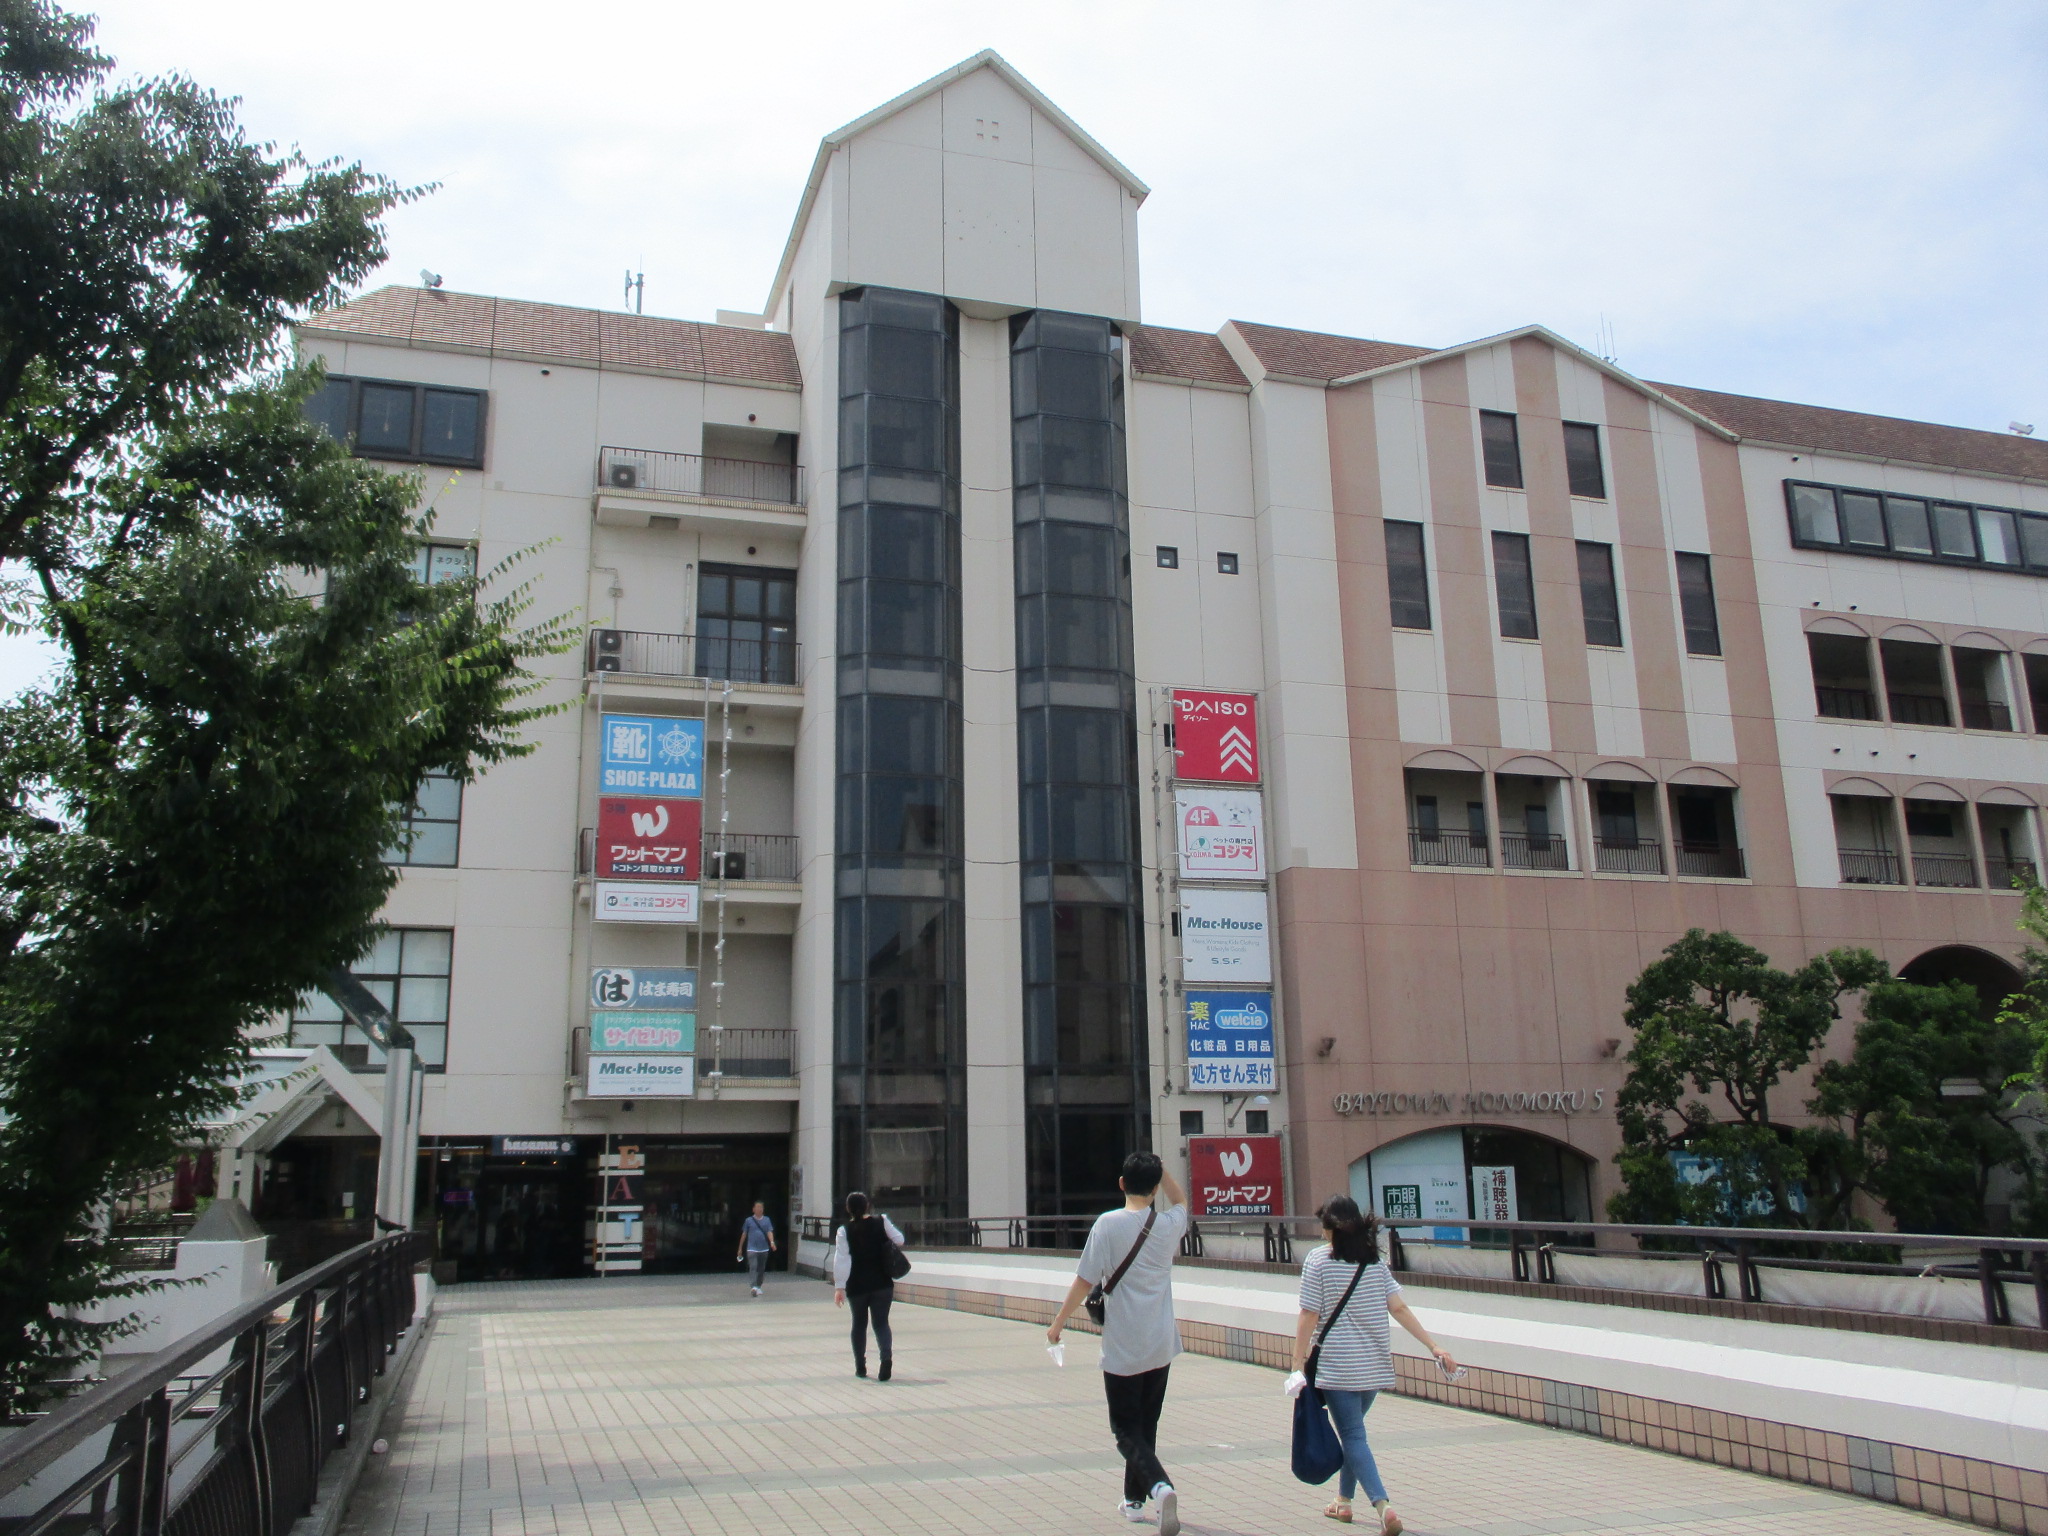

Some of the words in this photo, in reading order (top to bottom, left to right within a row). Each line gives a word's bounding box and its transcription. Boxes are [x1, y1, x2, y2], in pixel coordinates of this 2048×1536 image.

[1181, 699, 1247, 716] DAISO
[612, 726, 646, 758] 靴
[1190, 809, 1210, 824] 4F
[611, 845, 687, 862] ワットマン
[1213, 846, 1253, 859] コジマ
[655, 898, 686, 908] コジマ
[599, 974, 630, 1002] は
[638, 981, 692, 997] はま寿司
[1190, 1002, 1209, 1020] 薬
[1190, 1022, 1210, 1030] HAC
[604, 1027, 681, 1047] サイゼリヤ
[1190, 1040, 1227, 1052] 化粧品
[1235, 1040, 1271, 1052] 日用品
[1192, 1063, 1272, 1085] 処方せん受付
[1461, 1088, 1586, 1114] HONMOKU
[1591, 1088, 1604, 1111] 5
[1203, 1186, 1271, 1203] ワットマン
[1492, 1170, 1508, 1220] 補聴器
[1206, 1205, 1270, 1214] トコトン買取ります!
